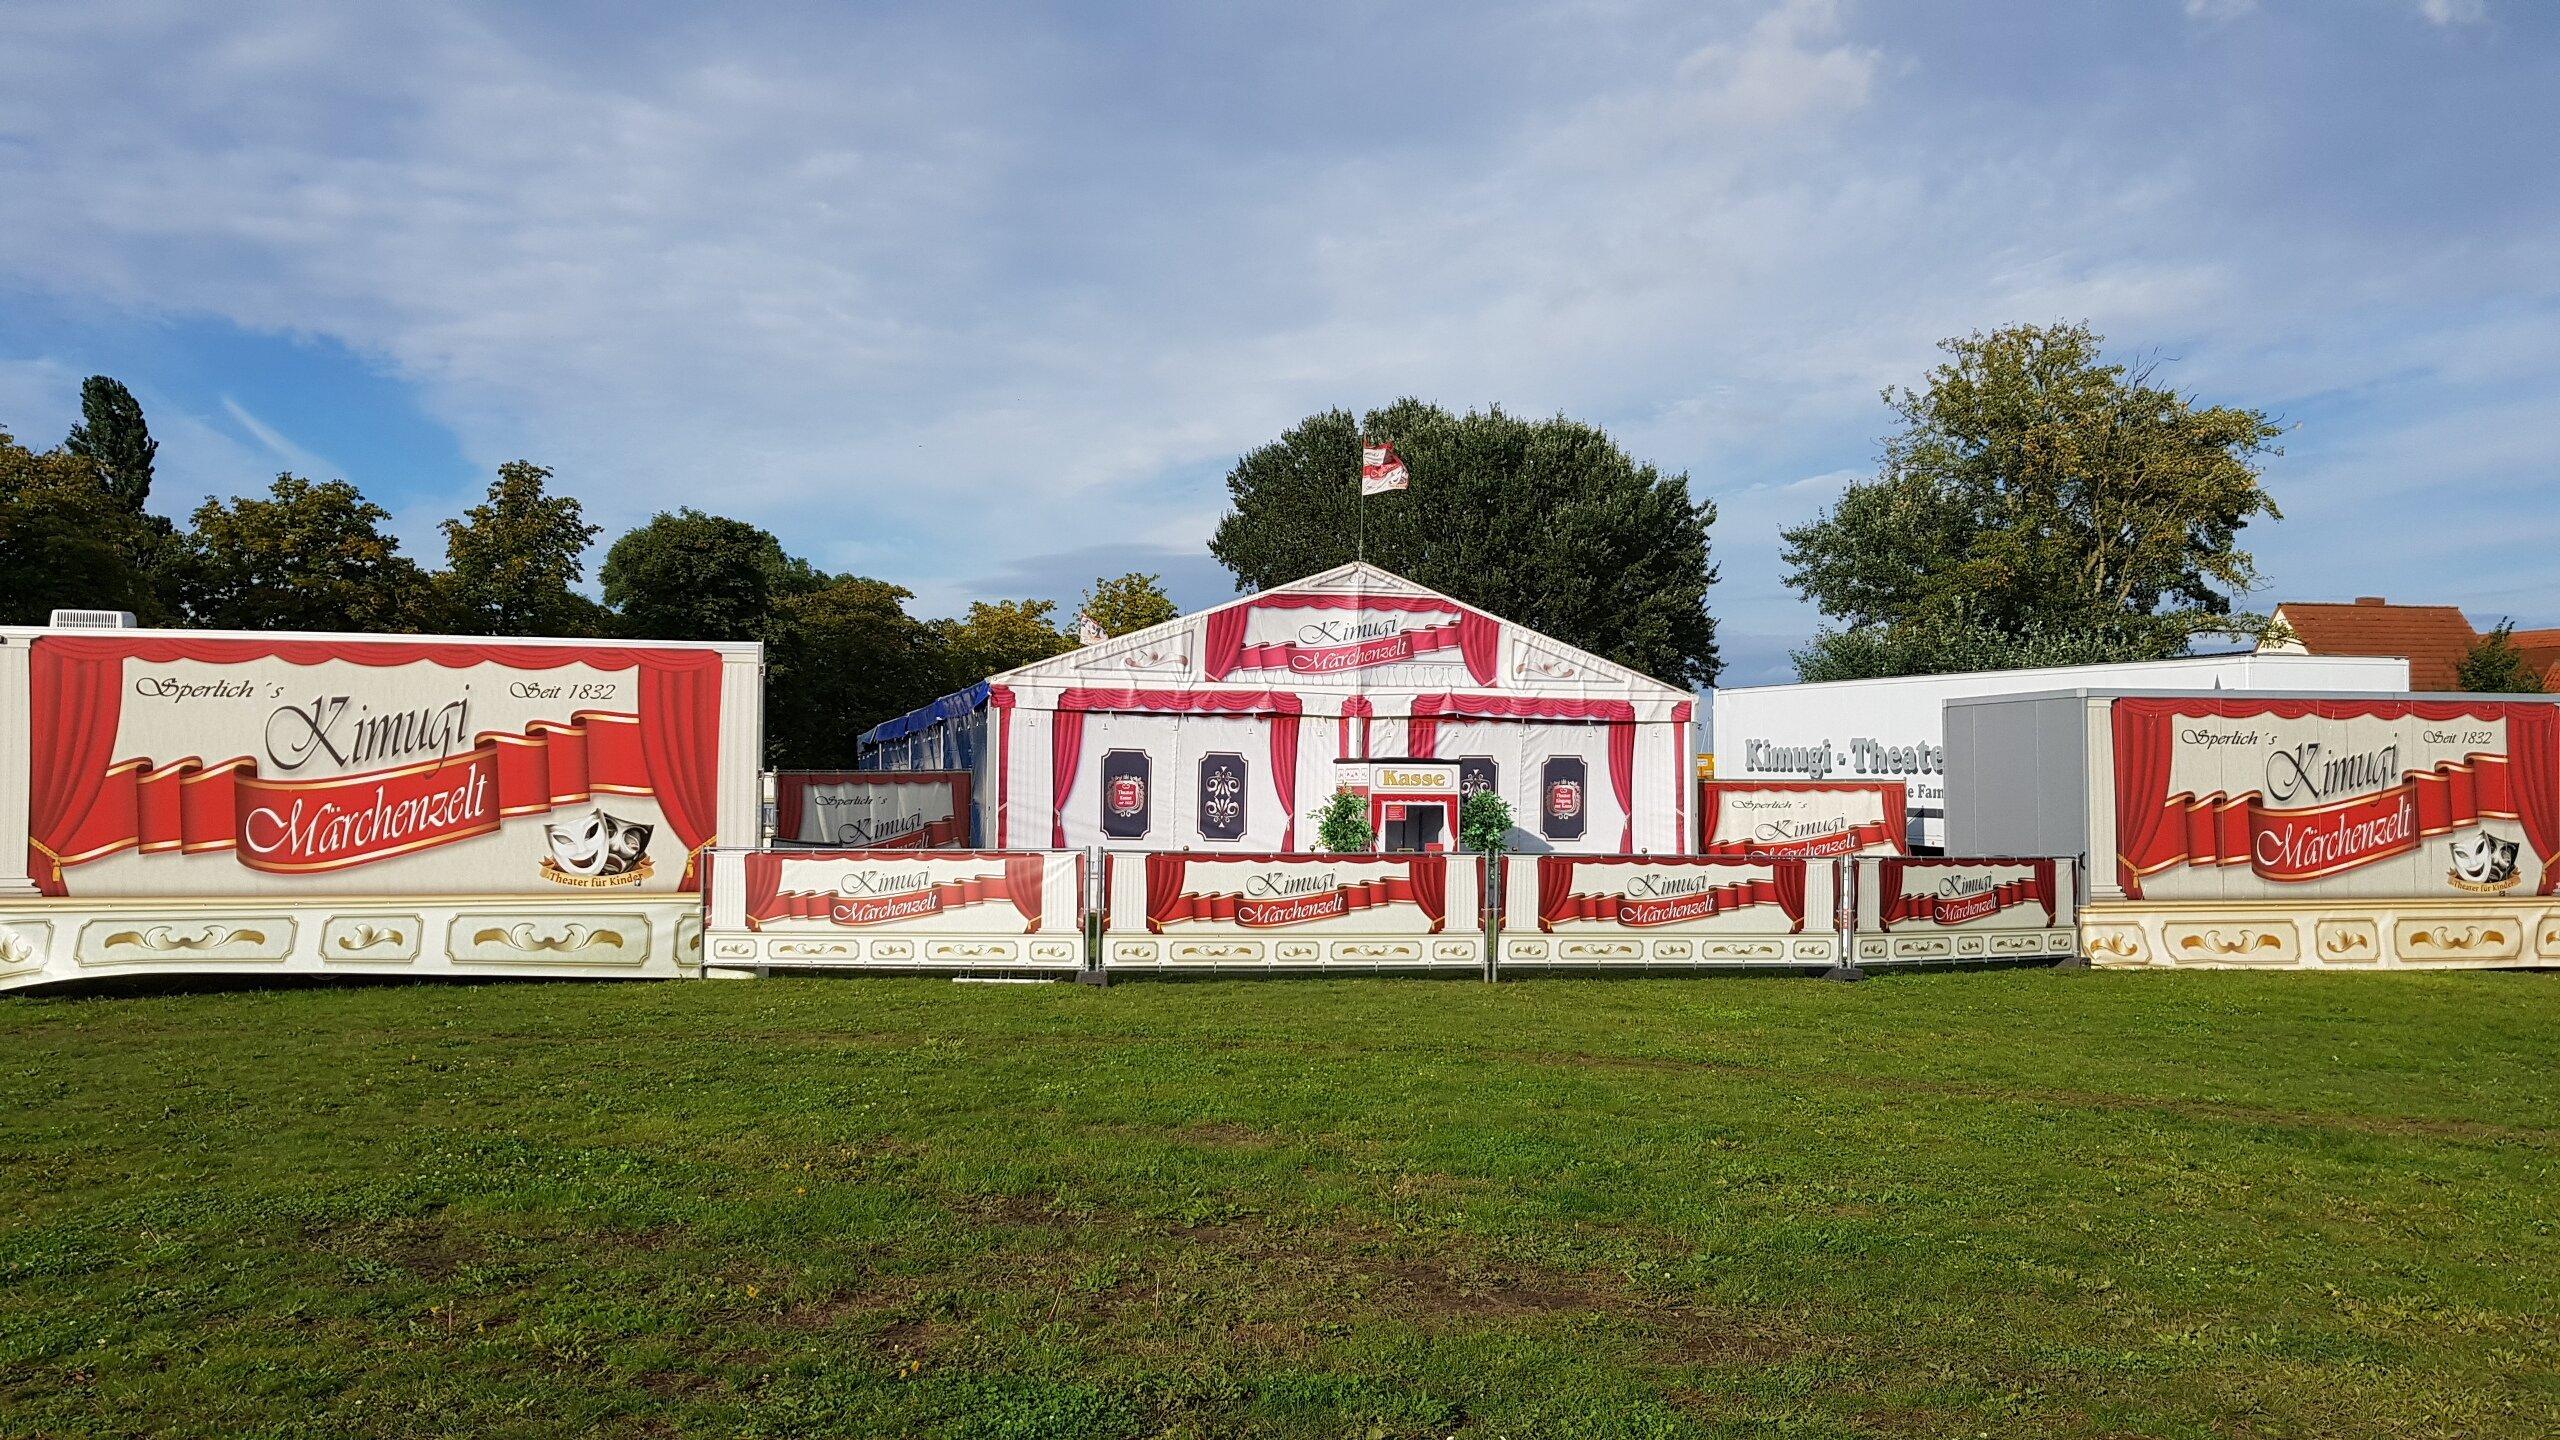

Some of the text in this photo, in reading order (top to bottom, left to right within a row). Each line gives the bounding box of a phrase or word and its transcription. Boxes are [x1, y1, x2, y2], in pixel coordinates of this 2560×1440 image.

[1299, 615, 1397, 644] Kimugi
[1292, 638, 1406, 670] Märchenzelt
[510, 682, 616, 700] Seit 1832
[265, 684, 471, 778] Kimugi
[2422, 730, 2493, 745] Seit 1832
[1745, 738, 1832, 779] Kimugi
[2265, 732, 2399, 806] Kimugi
[1383, 770, 1446, 786] Kasse
[245, 763, 488, 858] Märchenzelt
[838, 808, 921, 844] Kimugi
[1755, 813, 1845, 840] Kimugi
[2257, 795, 2412, 870] Märchenzelt
[550, 872, 644, 887] Theater für Kinder
[841, 866, 930, 894] Kimugi
[1246, 868, 1336, 896] Kimugi
[1627, 870, 1708, 896] Kimugi
[1939, 871, 1993, 896] Kimugi
[833, 891, 937, 921] Märchenzelt
[1238, 893, 1343, 923] Märchenzelt
[1620, 895, 1714, 923] Märchenzelt
[1935, 893, 1997, 920] Märchenzelt
